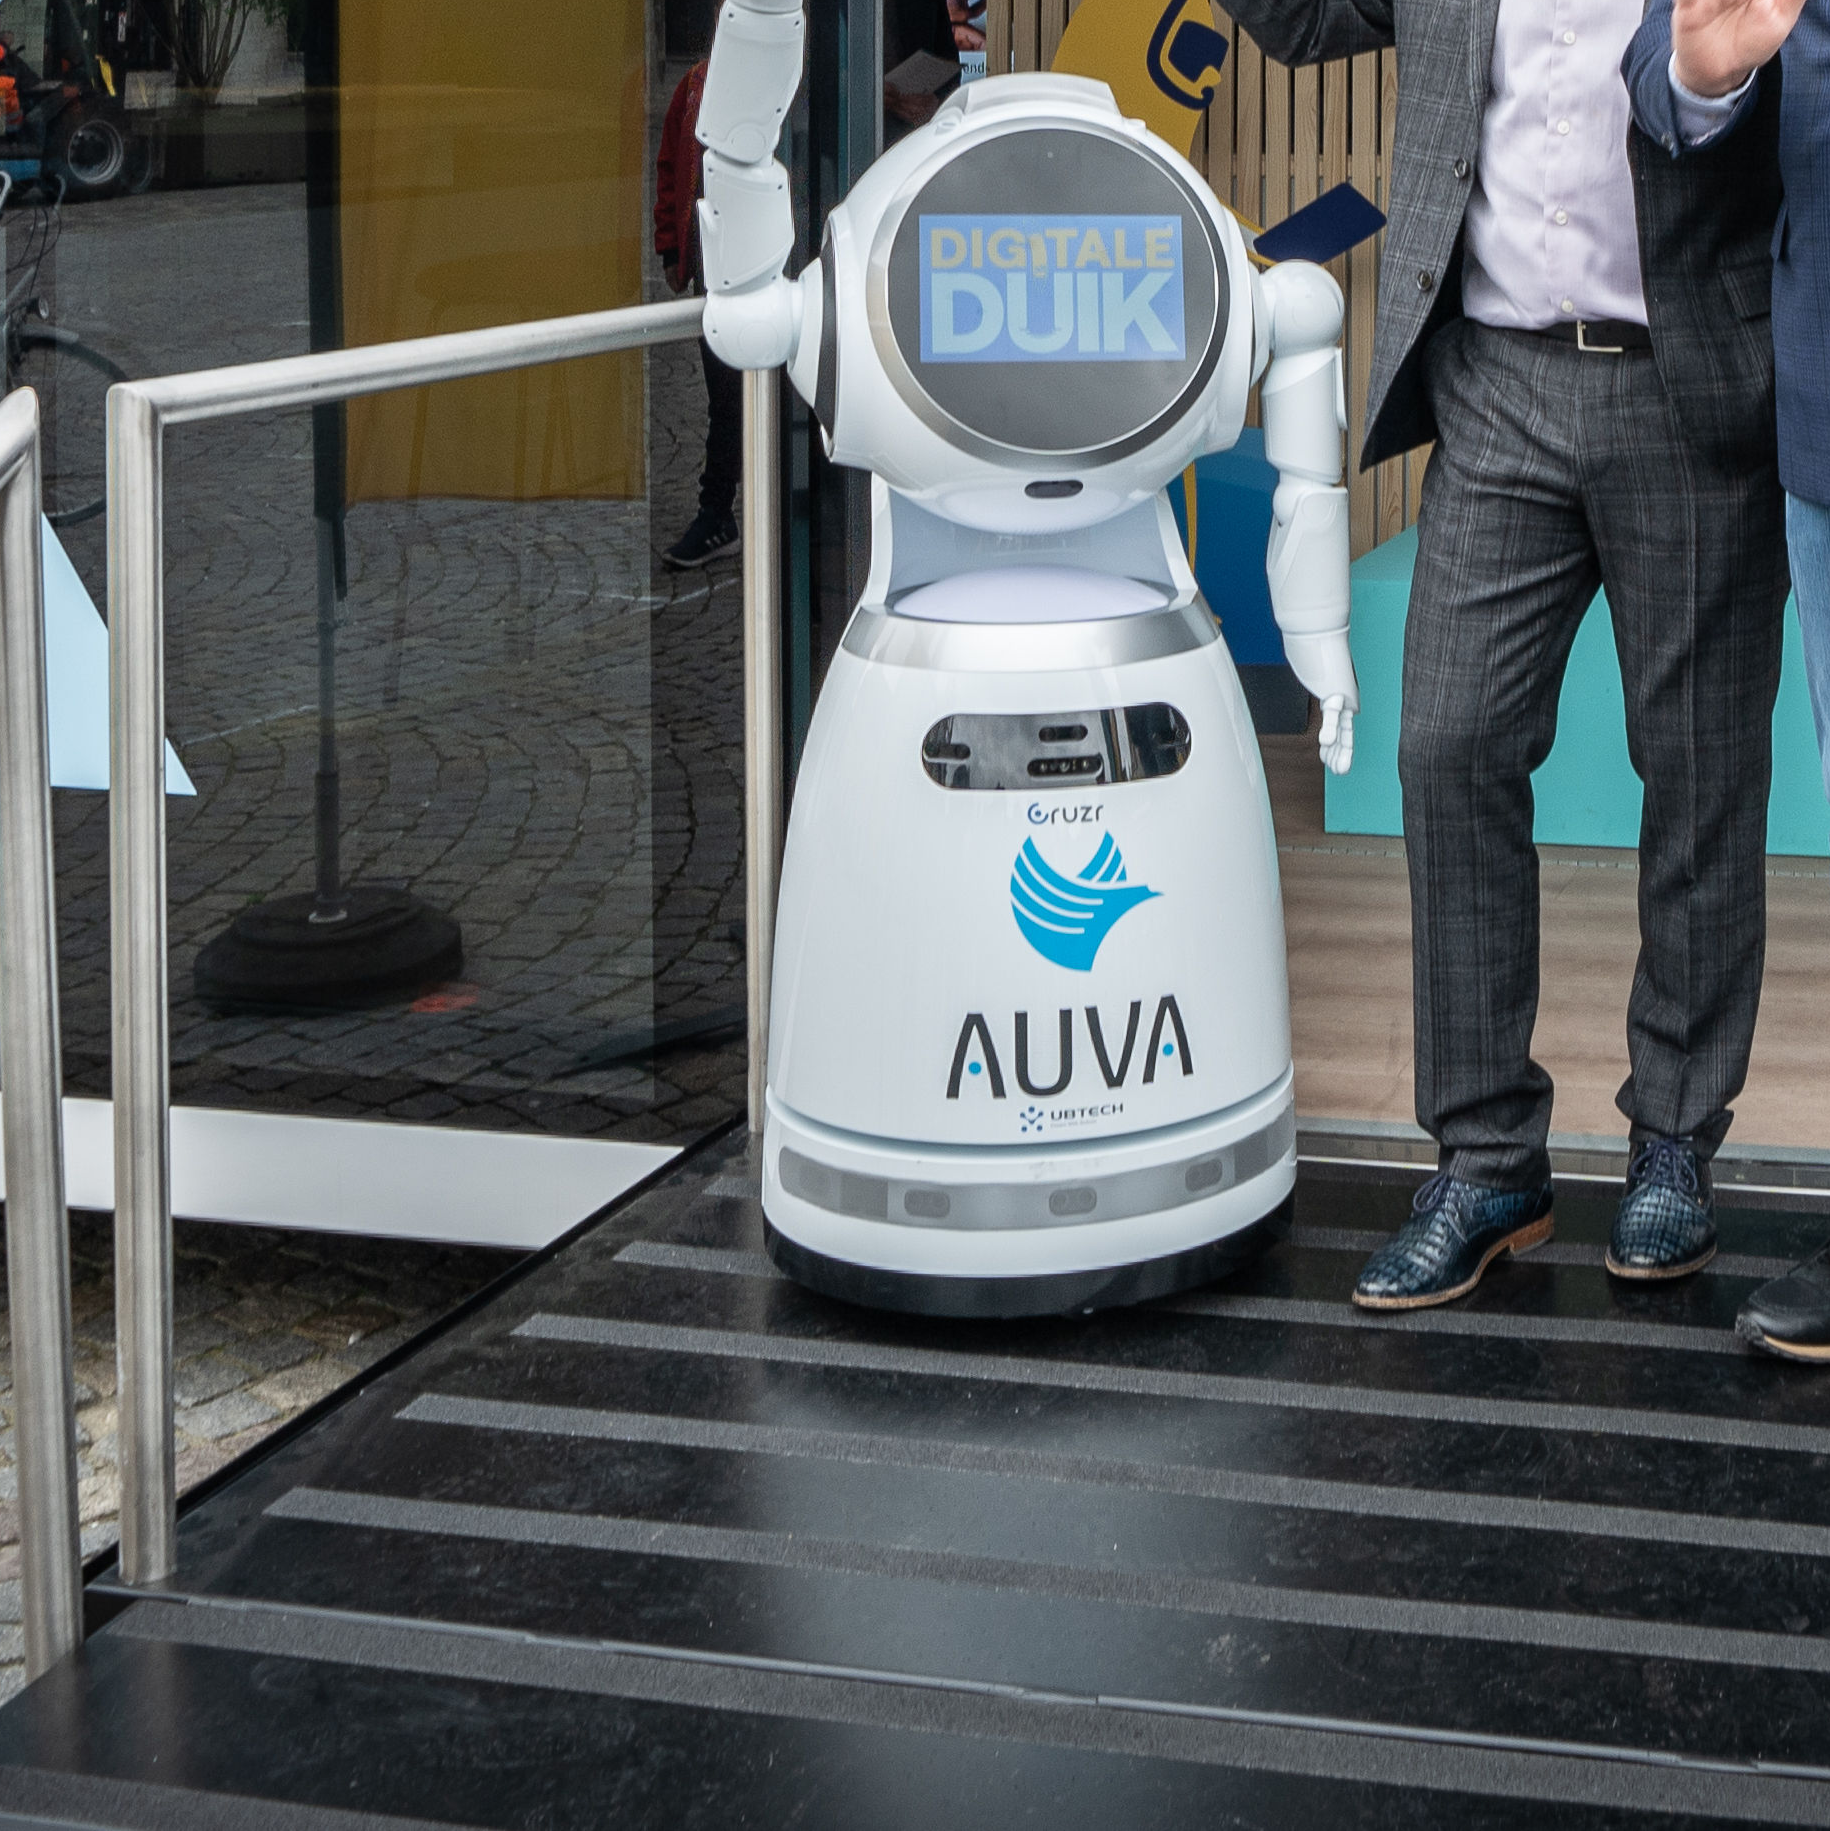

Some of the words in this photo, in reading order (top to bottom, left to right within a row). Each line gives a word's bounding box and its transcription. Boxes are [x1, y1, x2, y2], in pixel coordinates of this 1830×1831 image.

[930, 225, 1176, 273] DIGITALE
[930, 270, 1180, 354] DUIK
[945, 994, 1194, 1100] AUVA
[1050, 1102, 1124, 1121] UBTECH
